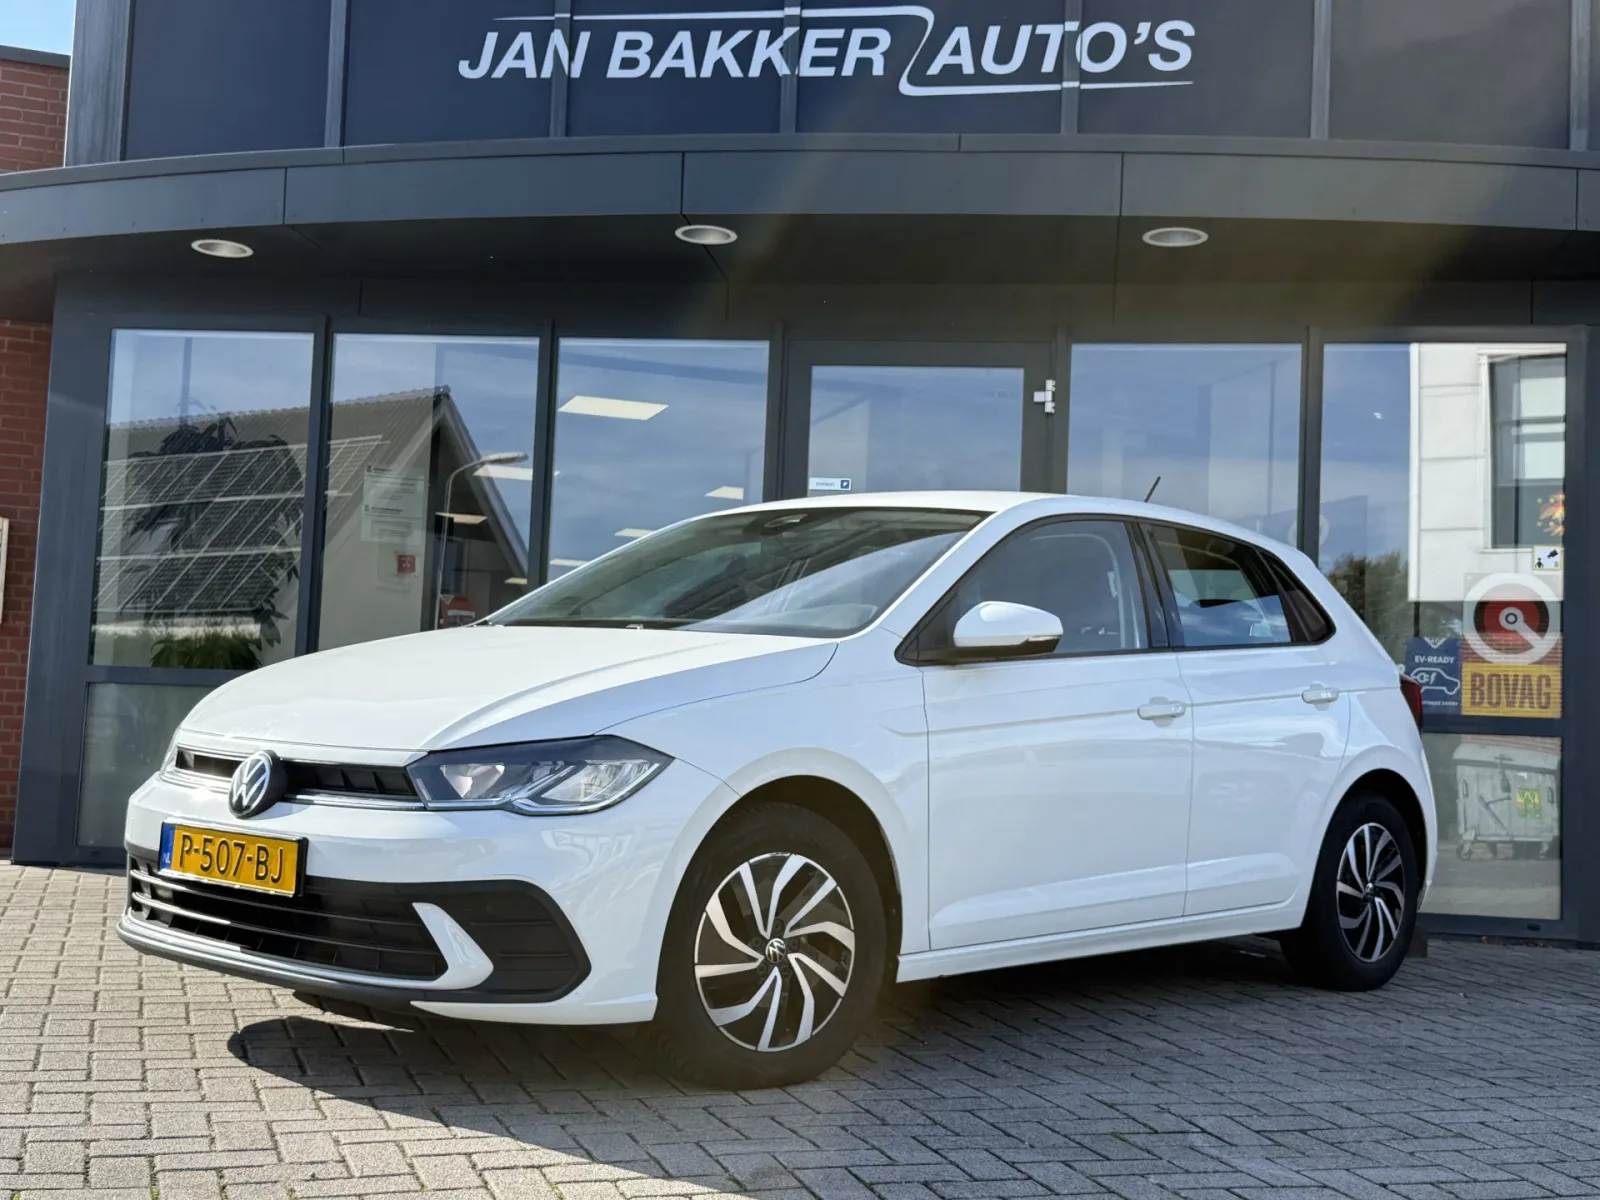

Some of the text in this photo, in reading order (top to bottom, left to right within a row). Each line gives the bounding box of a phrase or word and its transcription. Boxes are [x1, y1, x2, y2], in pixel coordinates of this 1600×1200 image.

[457, 19, 1196, 79] JAN BAKKER AUTO'S
[1414, 655, 1456, 664] EV-READY
[1470, 671, 1552, 709] BOVAG
[179, 834, 284, 884] P-507-BJ
